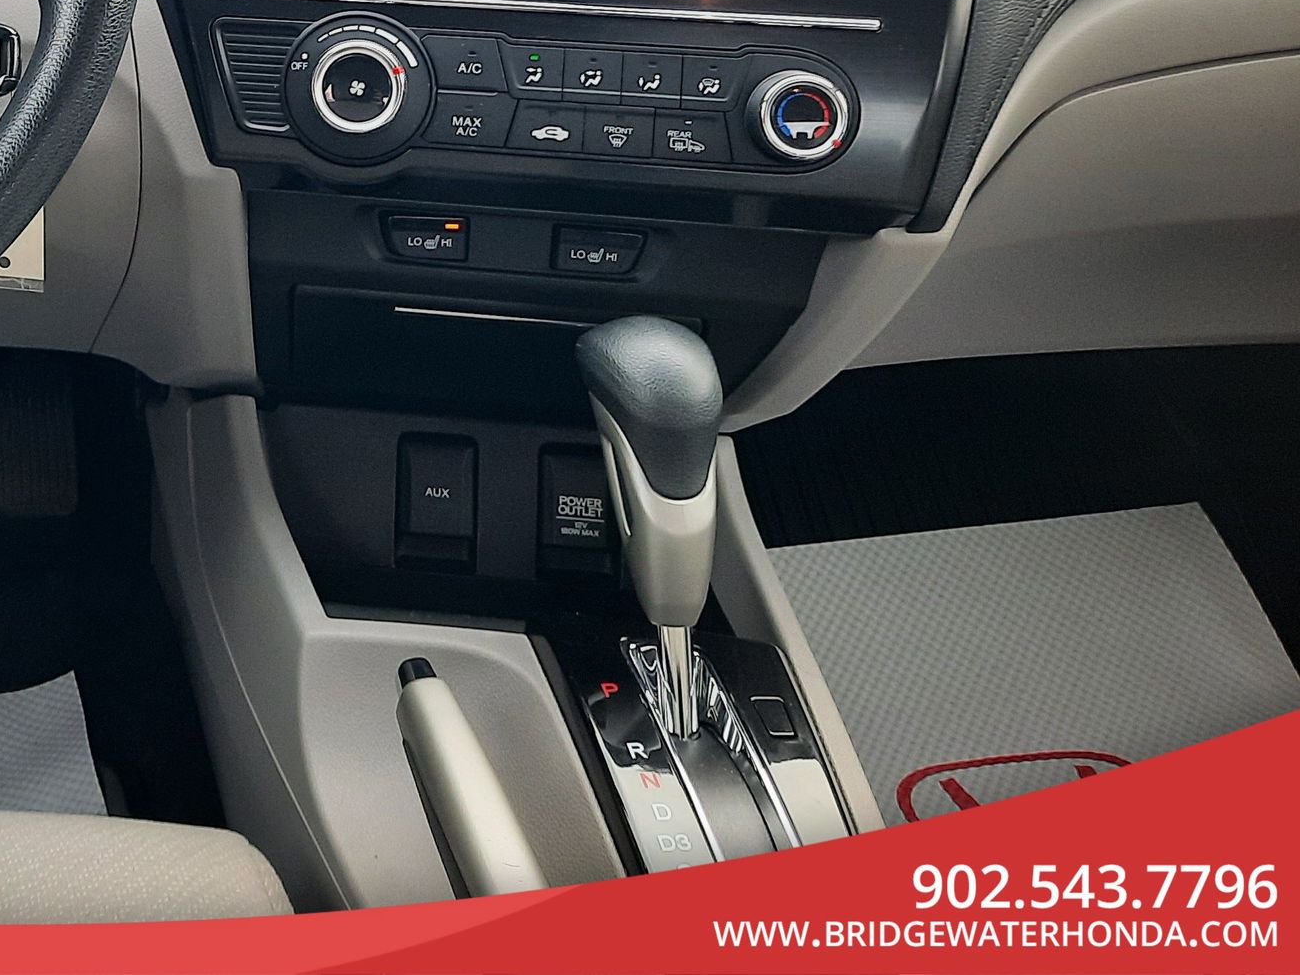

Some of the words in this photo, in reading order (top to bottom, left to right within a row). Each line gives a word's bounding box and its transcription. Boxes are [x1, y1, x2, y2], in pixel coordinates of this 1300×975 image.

[290, 61, 308, 71] OFF
[457, 62, 481, 75] A/C
[453, 117, 482, 128] MAX
[456, 126, 480, 136] A/C
[603, 125, 633, 136] FRONT
[666, 129, 693, 139] REAR
[571, 250, 585, 258] LO
[606, 253, 617, 261] HI
[425, 488, 450, 498] AUX
[559, 495, 602, 507] POWER
[558, 505, 602, 517] OUTLET
[600, 683, 619, 698] P
[626, 742, 649, 759] R
[640, 773, 660, 788] N
[652, 804, 671, 820] D
[658, 835, 692, 852] D3
